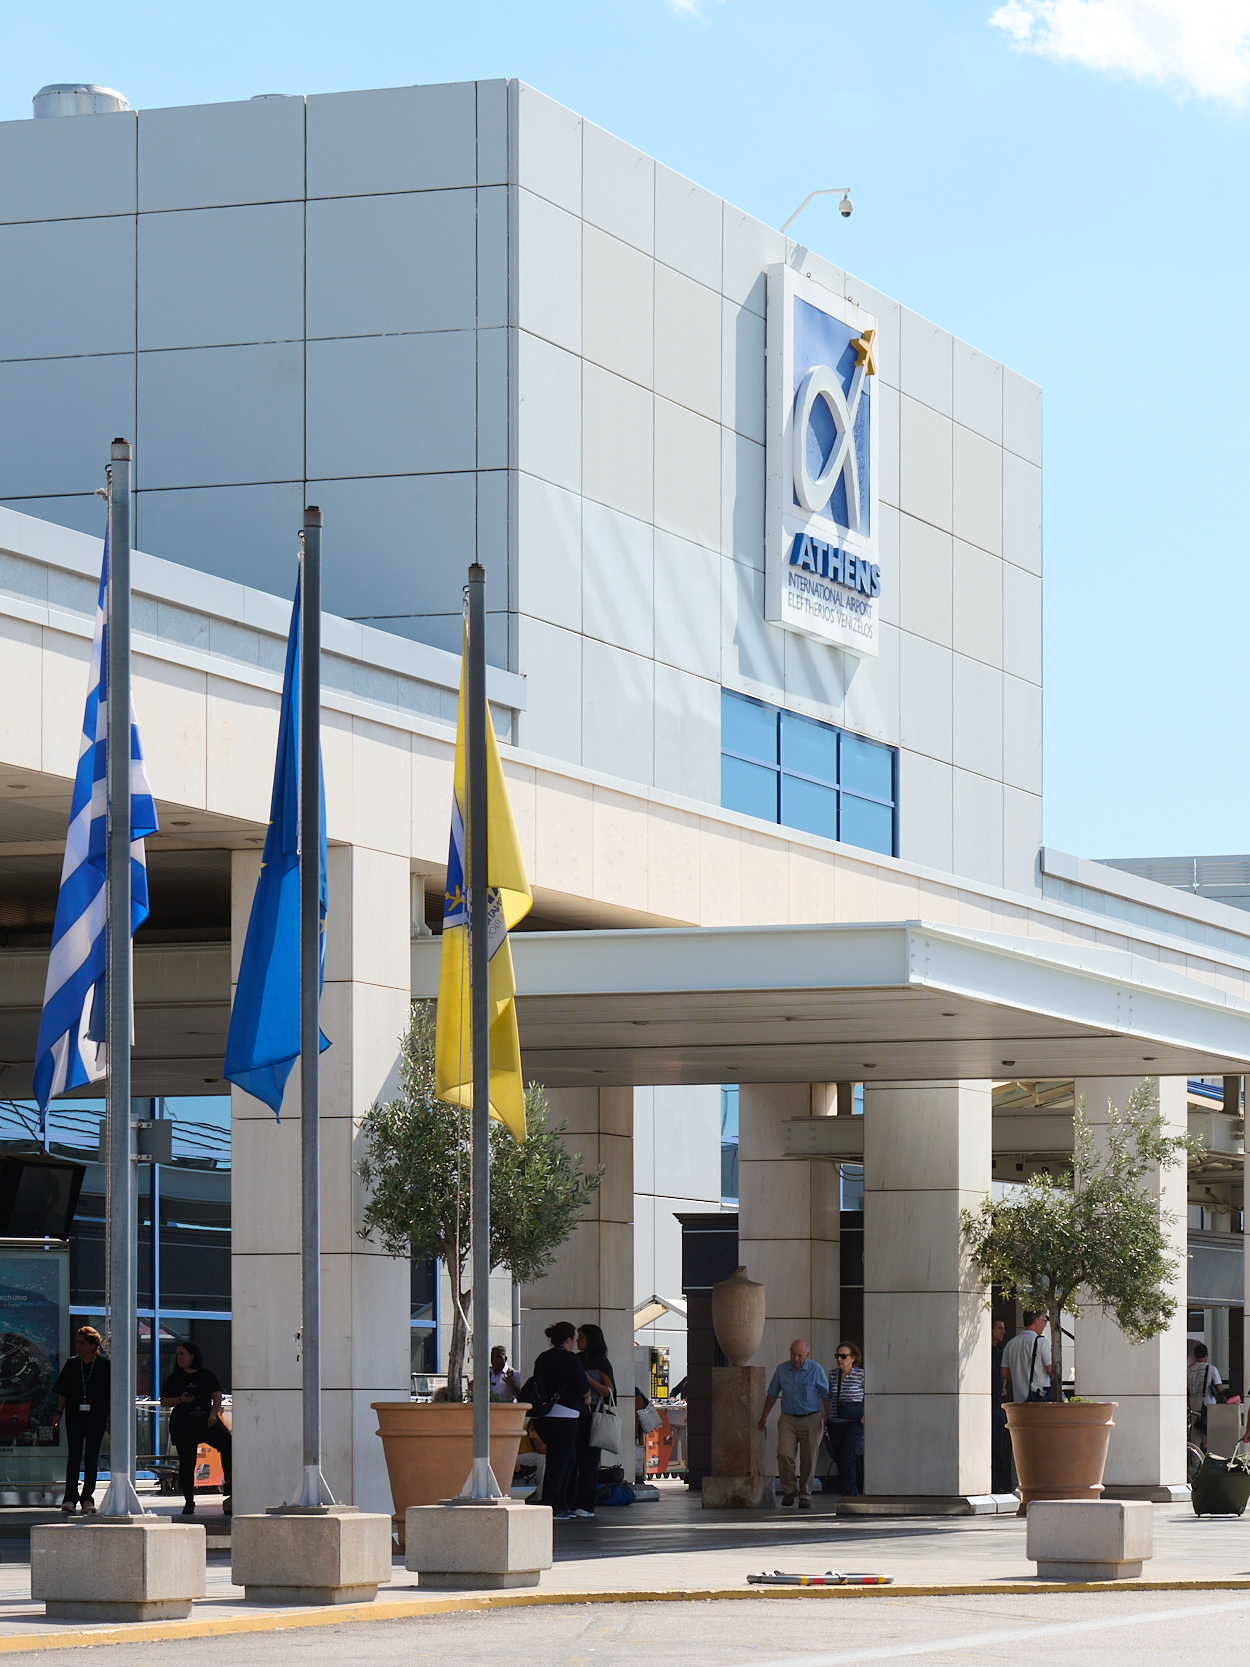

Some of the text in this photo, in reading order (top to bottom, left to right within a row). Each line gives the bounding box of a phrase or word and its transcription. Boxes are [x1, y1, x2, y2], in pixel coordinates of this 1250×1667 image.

[789, 533, 881, 598] ATHENS
[788, 571, 873, 619] INTERNATIONAL AIRPORT
[788, 591, 873, 639] ELEFTHERIOS VENIZELOS
